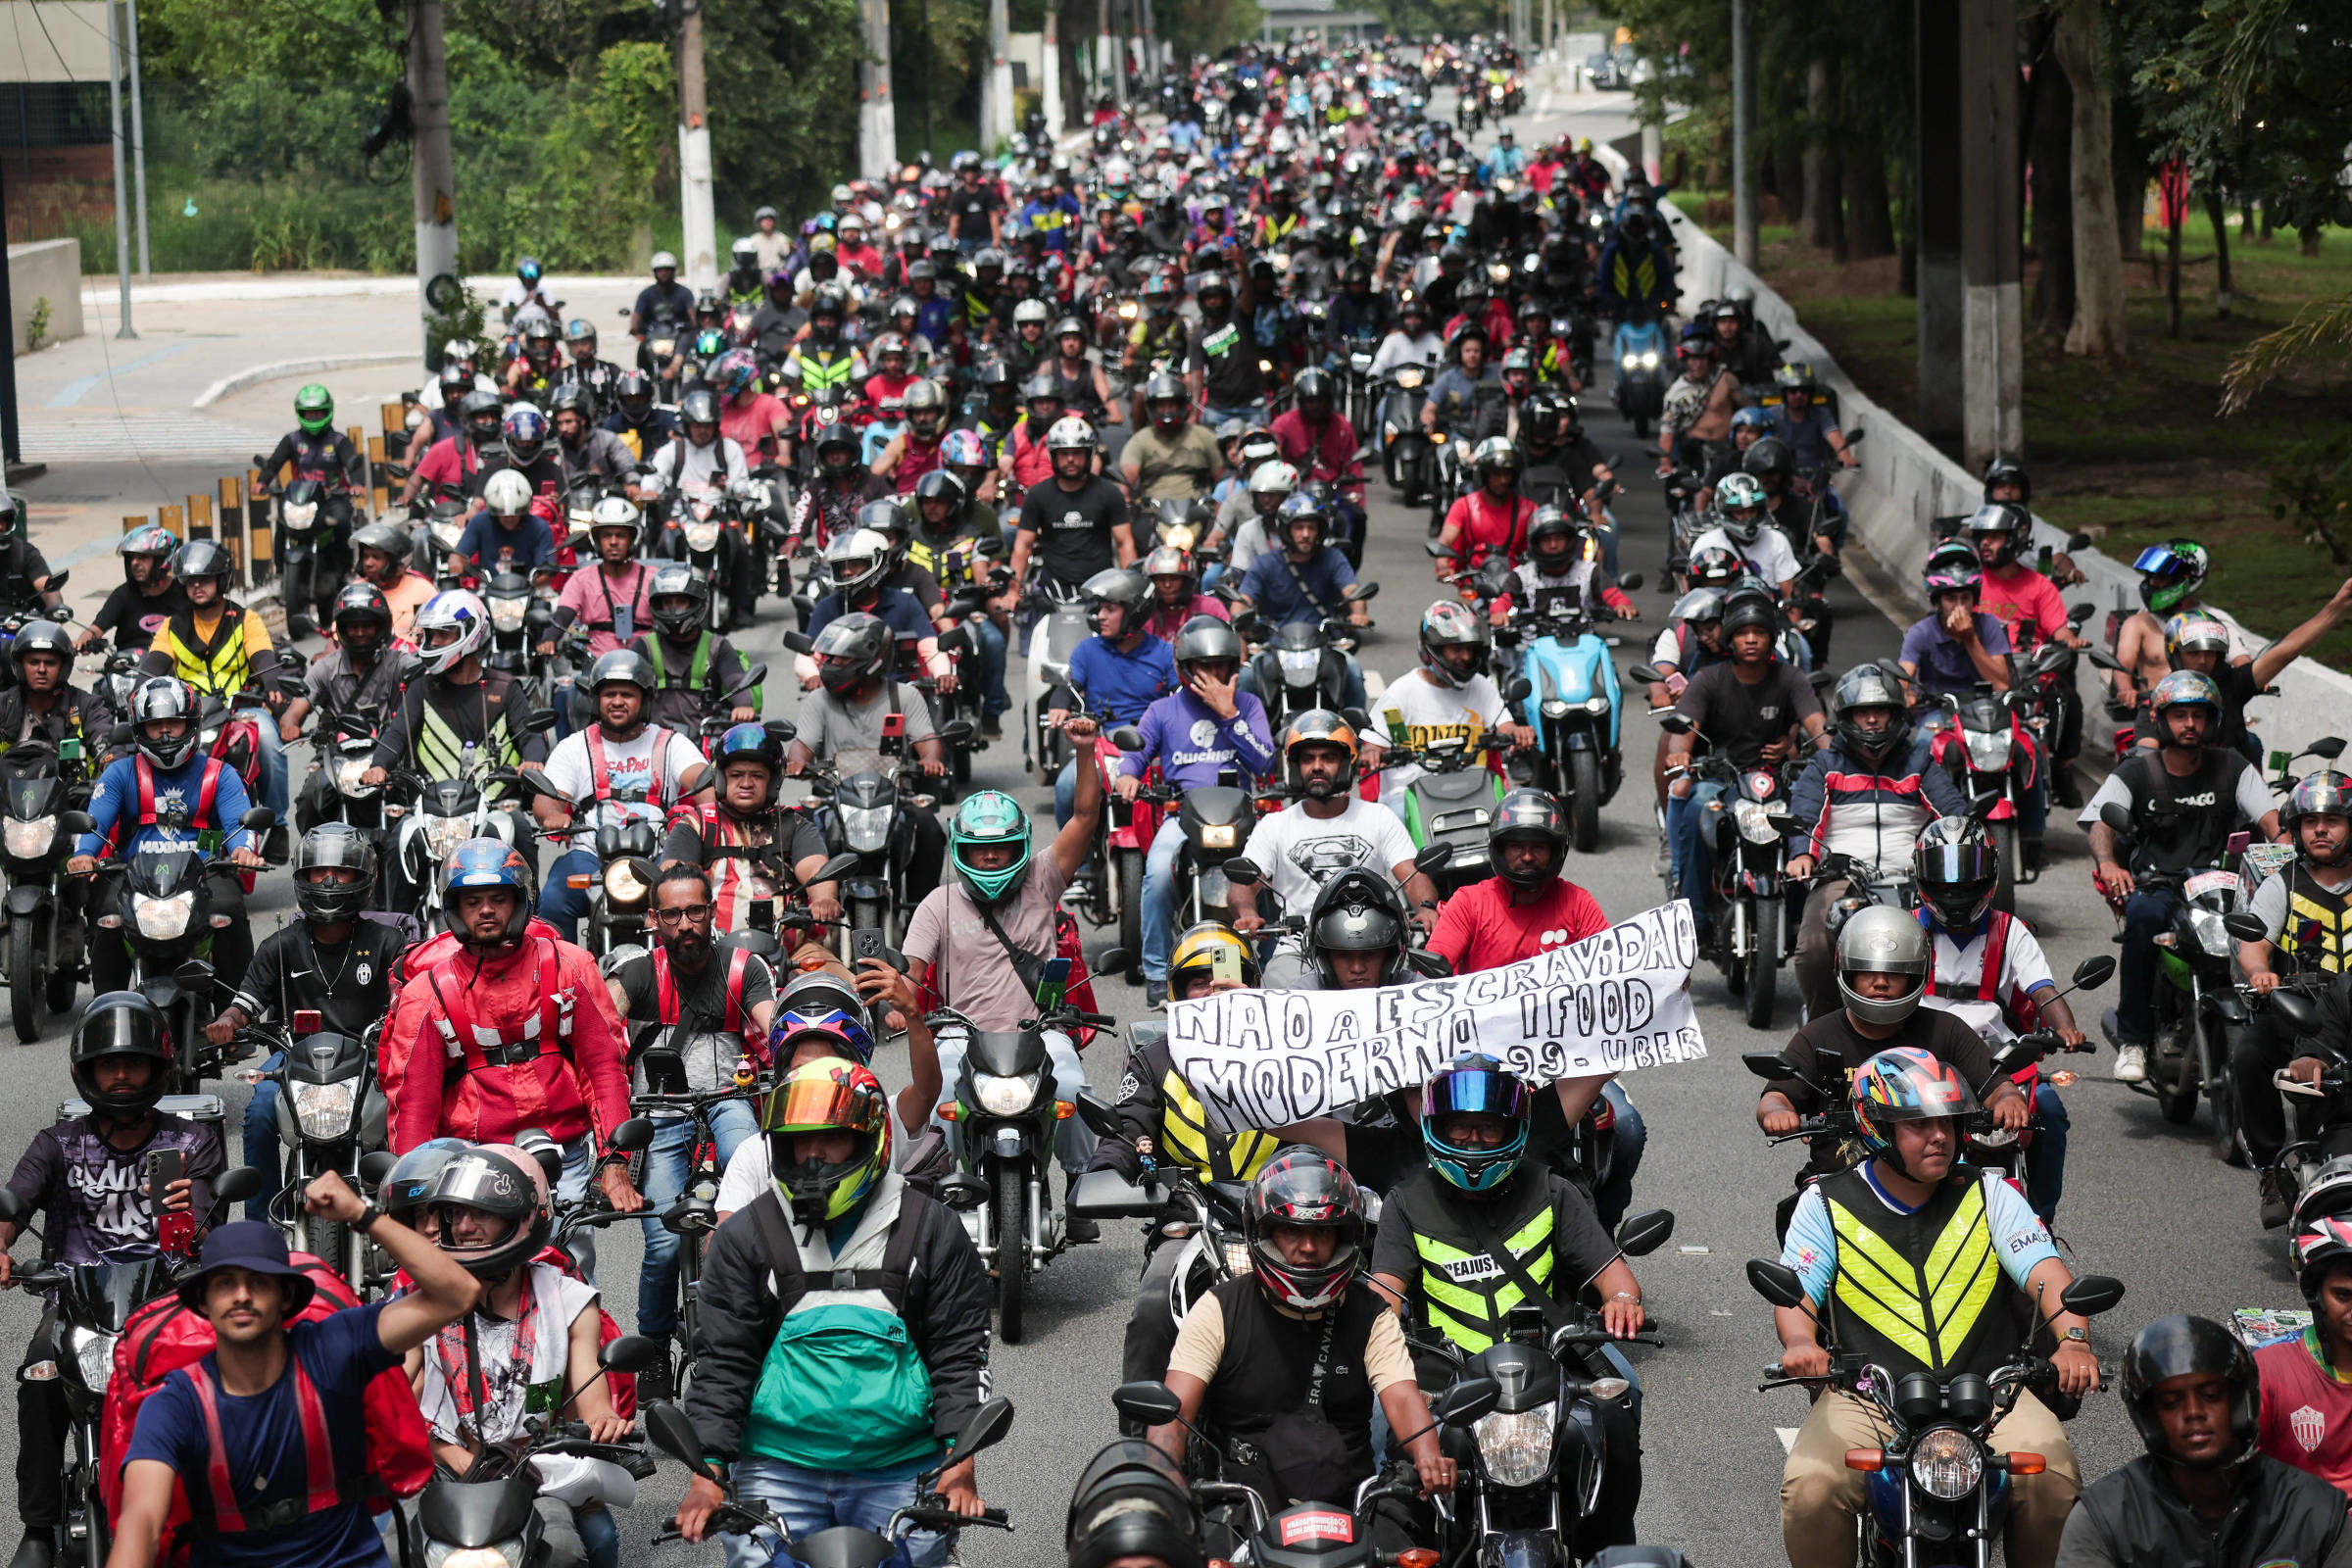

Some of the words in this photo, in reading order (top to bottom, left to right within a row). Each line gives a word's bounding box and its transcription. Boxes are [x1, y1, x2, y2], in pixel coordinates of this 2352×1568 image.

[1175, 988, 1312, 1052] NÃO
[1326, 1009, 1360, 1044] A
[1185, 1008, 1482, 1132] MODERNA
[1600, 1027, 1709, 1072] UBER
[2009, 1229, 2052, 1253] EMAÚS
